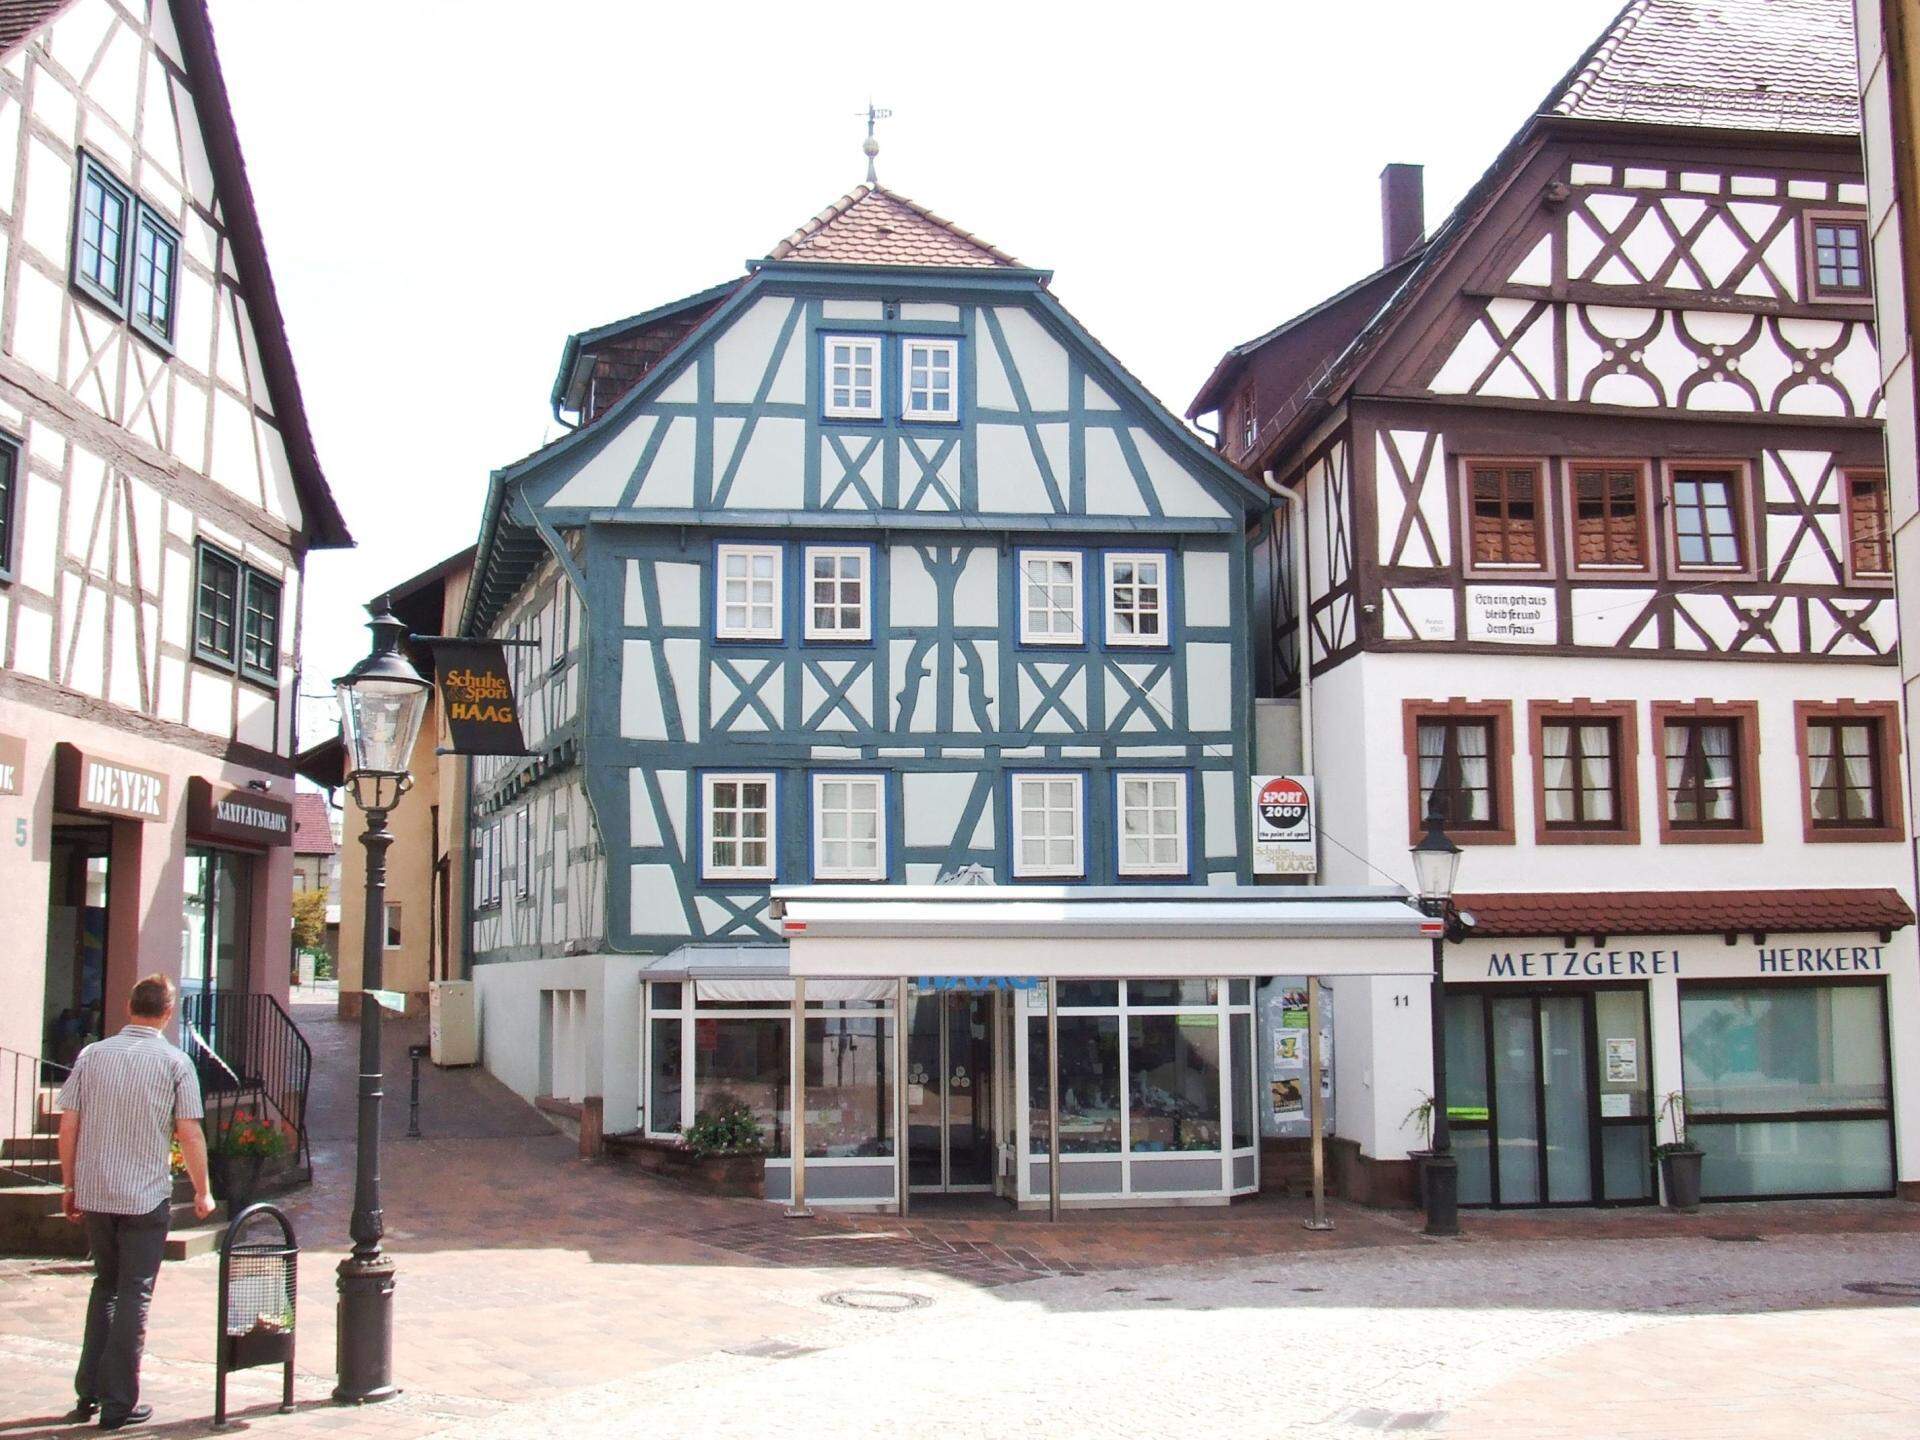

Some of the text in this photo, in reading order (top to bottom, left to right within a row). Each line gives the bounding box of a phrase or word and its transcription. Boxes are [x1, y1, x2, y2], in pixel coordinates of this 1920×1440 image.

[1528, 596, 1548, 606] aus
[446, 668, 506, 689] Schuhe
[465, 686, 509, 703] Sport
[451, 702, 513, 724] HAAG
[87, 762, 161, 816] BEYER
[1262, 791, 1303, 804] SPORT
[1264, 806, 1302, 818] 2000
[15, 817, 28, 848] 5
[1275, 861, 1316, 873] HAAG
[1487, 945, 1886, 977] METZGEREI HERKERT
[1392, 994, 1409, 1007] 11
